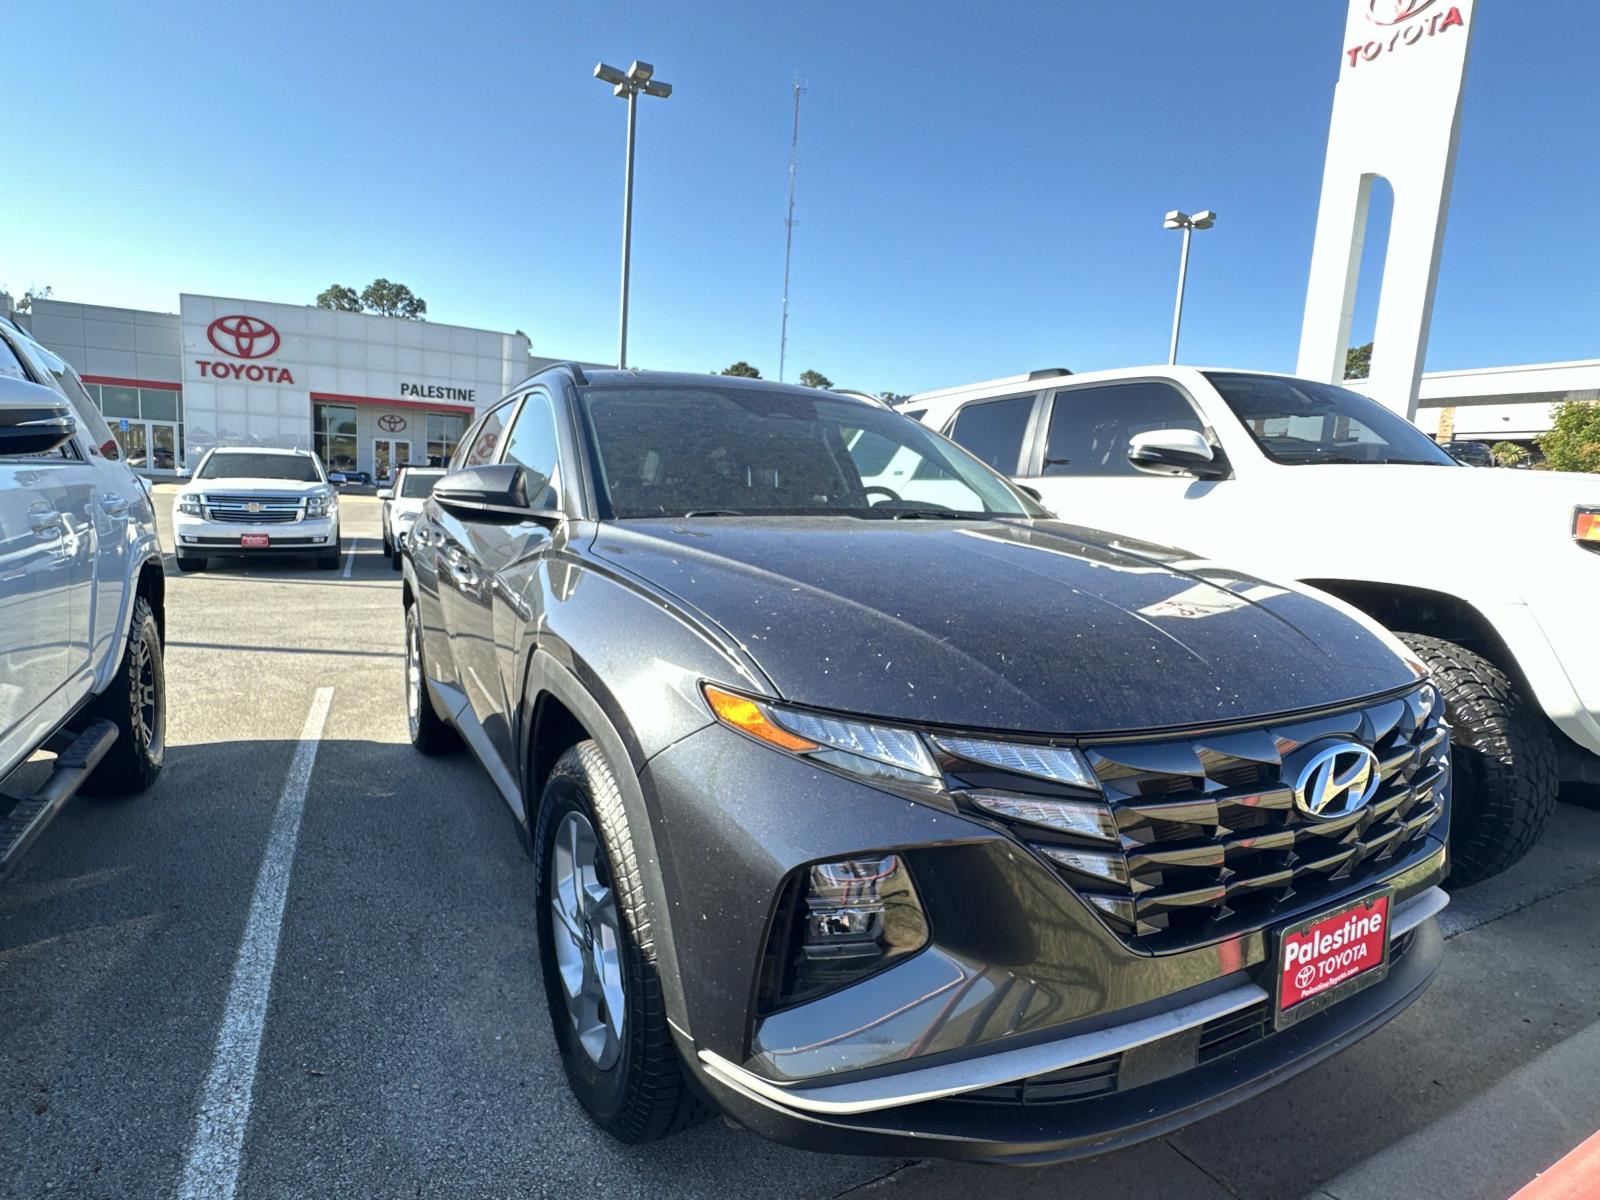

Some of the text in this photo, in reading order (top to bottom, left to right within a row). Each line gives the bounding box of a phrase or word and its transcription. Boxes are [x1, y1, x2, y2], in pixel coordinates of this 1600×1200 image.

[1347, 6, 1464, 68] TOYOTA
[195, 360, 294, 384] TOYOTA
[400, 382, 476, 402] PALESTINE
[1284, 913, 1382, 972] Palestine
[1318, 942, 1367, 978] TOYOTA
